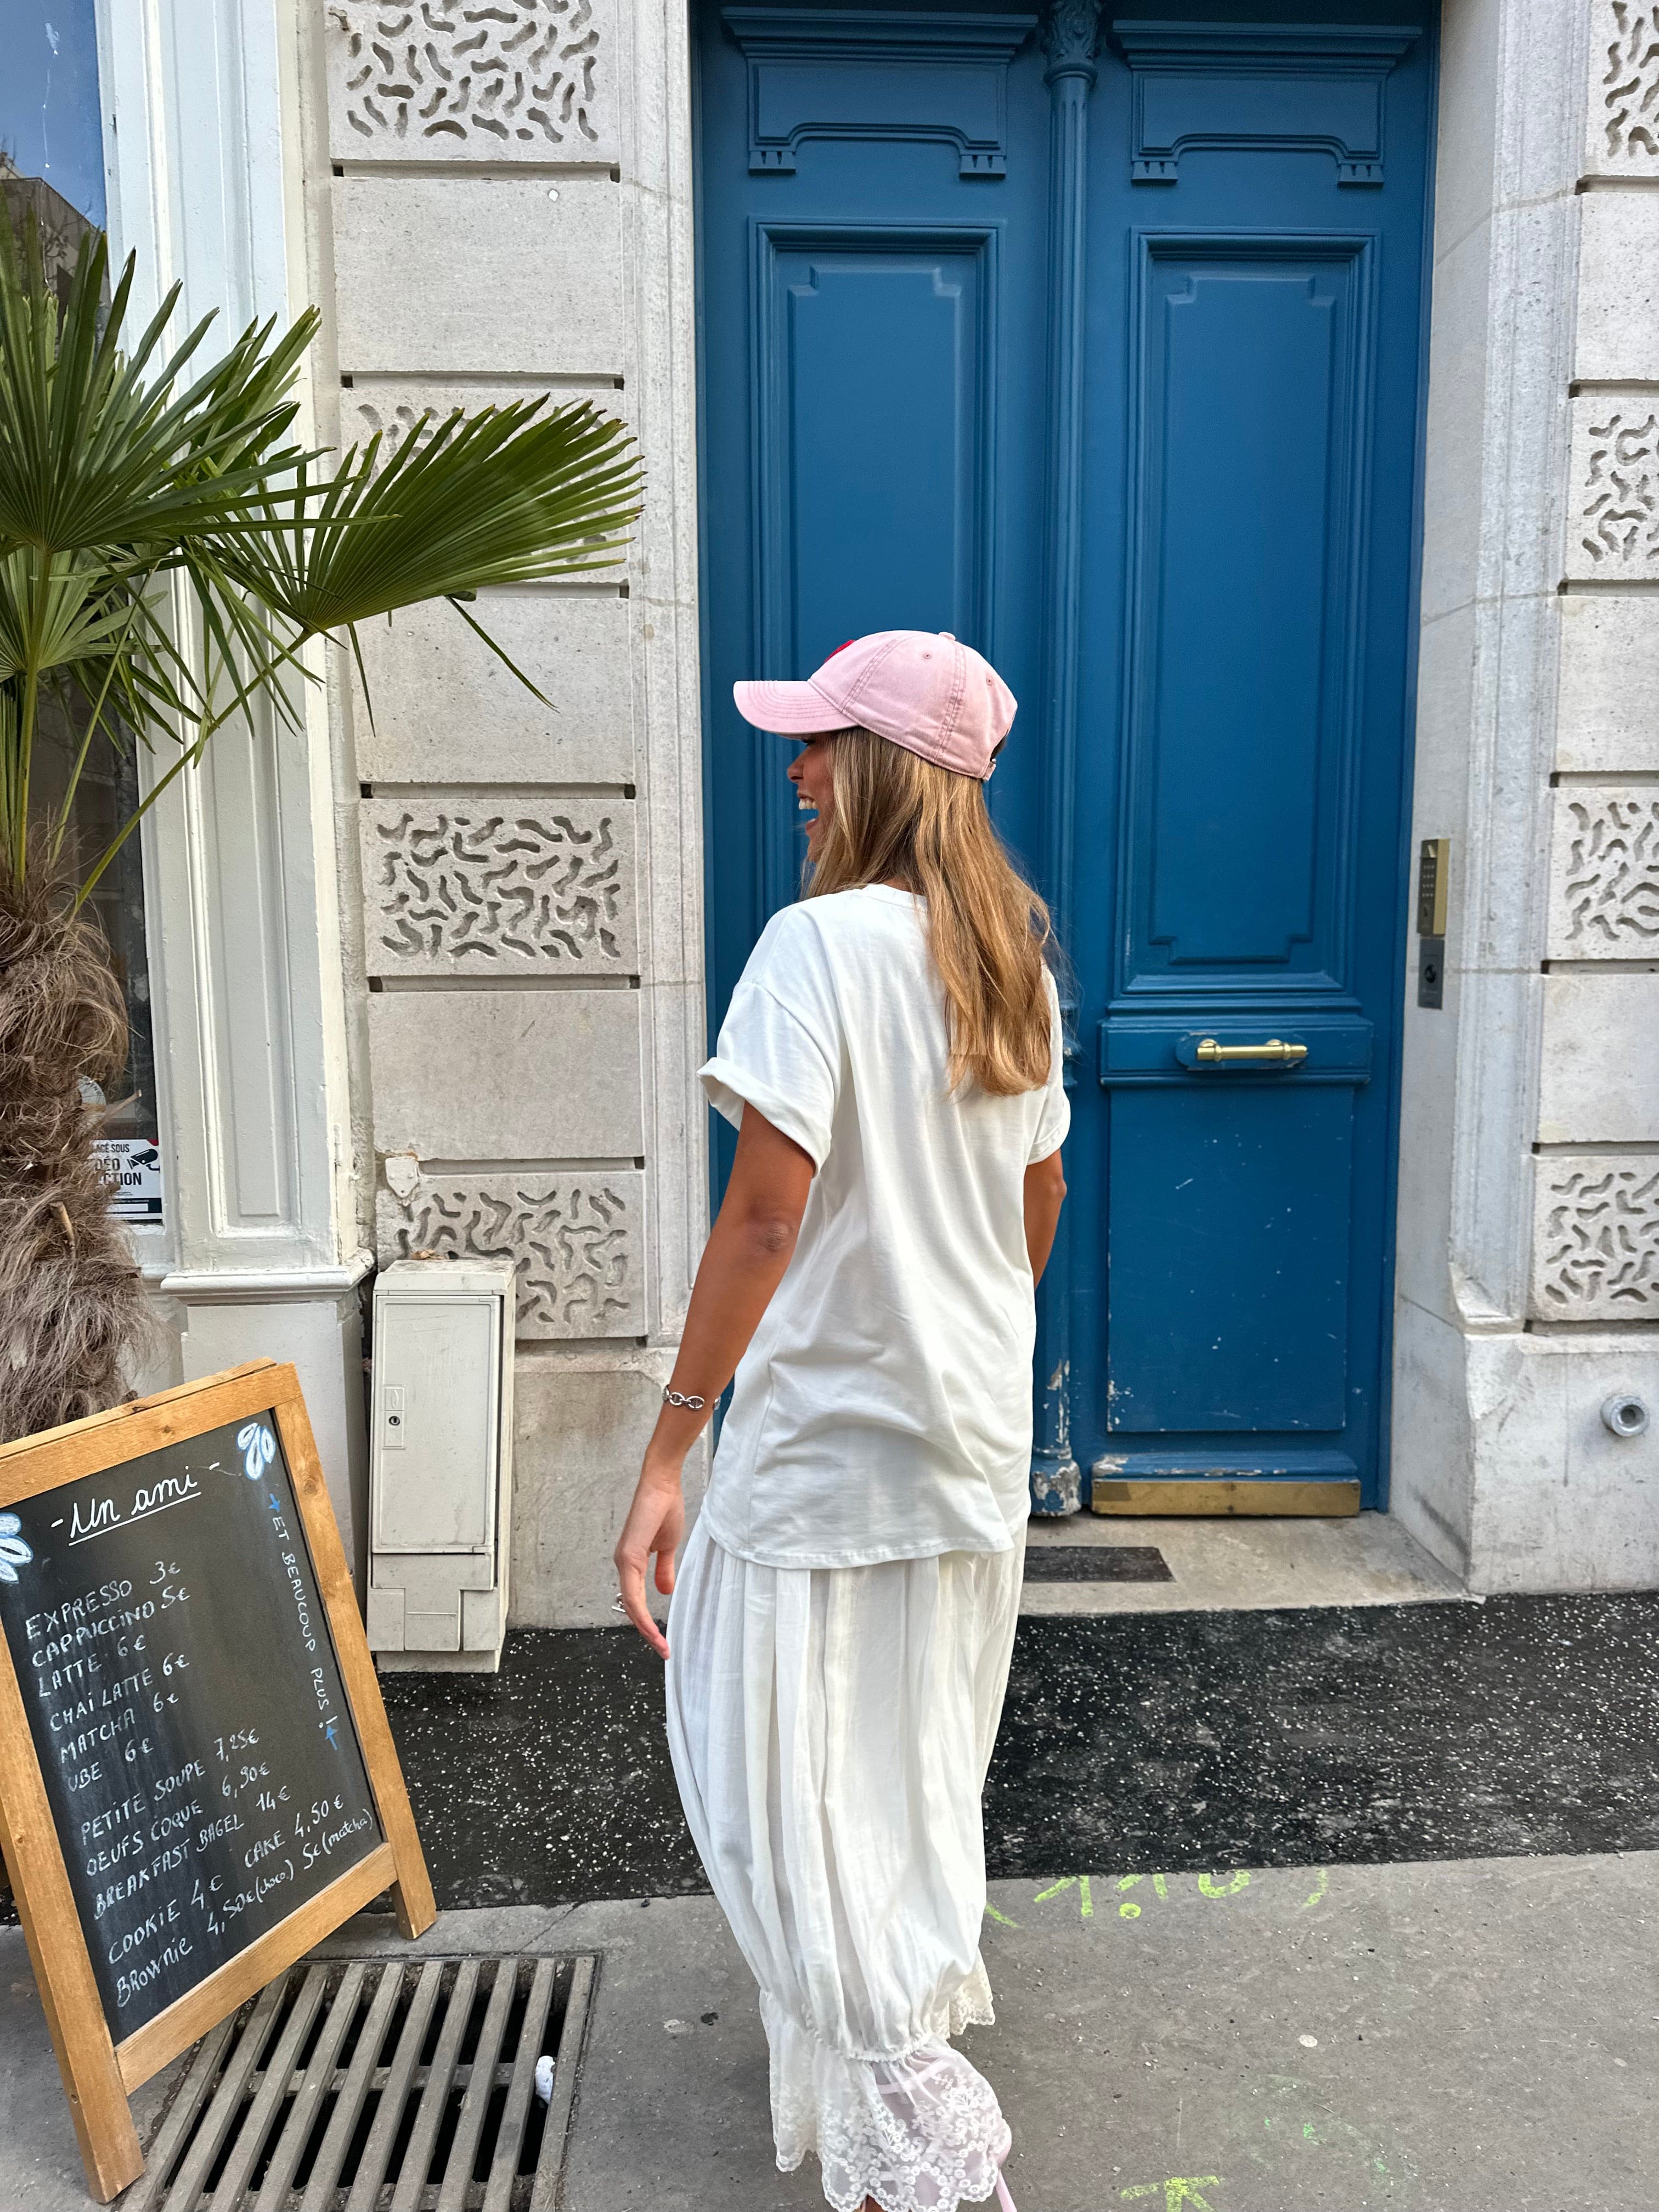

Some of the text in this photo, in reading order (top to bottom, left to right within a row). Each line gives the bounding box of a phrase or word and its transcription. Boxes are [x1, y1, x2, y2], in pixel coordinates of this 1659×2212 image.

[111, 1144, 129, 1153] SOUS
[273, 1517, 290, 1541] ET
[282, 1551, 315, 1651] BEAUCOUP
[25, 1580, 132, 1639] EXPRESSO
[39, 1653, 102, 1697] LATTE
[102, 1668, 153, 1707] LATTE
[60, 1708, 135, 1763] MATCHA
[67, 1762, 103, 1792] UBE
[154, 1759, 206, 1801] SOUPE
[87, 1831, 143, 1876] OEUFS
[151, 1799, 204, 1841] COQUE
[245, 1830, 285, 1867] CAKE
[94, 1838, 190, 1920] BREAKFAST
[196, 1814, 245, 1852] BAGEL
